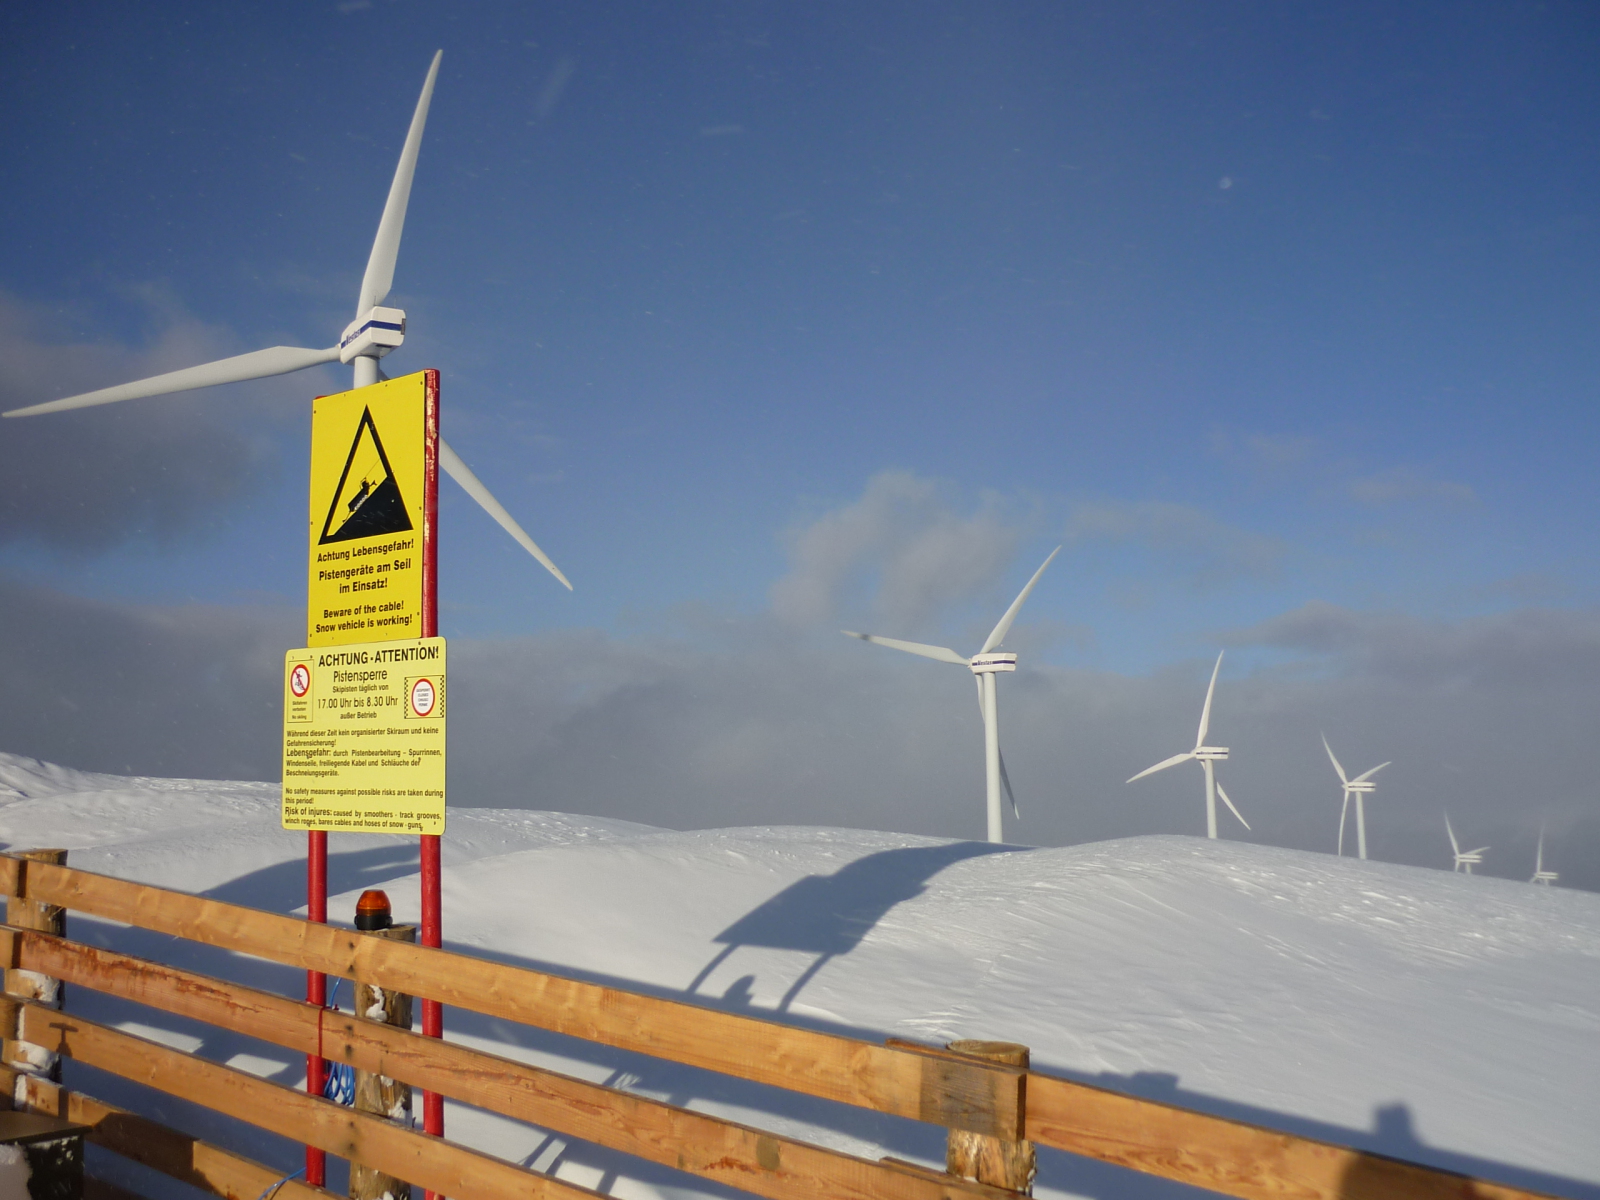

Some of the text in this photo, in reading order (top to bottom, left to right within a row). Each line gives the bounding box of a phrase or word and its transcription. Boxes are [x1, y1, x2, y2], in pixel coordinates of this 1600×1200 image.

[318, 539, 414, 562] Achtung Lebensgefahr!
[319, 565, 373, 581] Pistengeräte
[394, 558, 411, 570] Seil
[340, 578, 387, 593] im Einsatz!
[324, 600, 404, 618] Beware of the cable!
[316, 614, 412, 633] Snow vehicle is working!
[318, 652, 368, 667] ACHTUNG
[375, 646, 438, 663] ATTENTION!
[334, 670, 387, 683] Pistensperre
[332, 686, 357, 694] Skipisten
[359, 684, 377, 693] täglich
[318, 696, 398, 709] 17.00 Uhr bis 8.30 Uhr
[351, 728, 385, 737] organisierter
[286, 748, 331, 758] Lebensgefahr:
[352, 749, 401, 757] Pistenbearbeitung
[409, 749, 442, 757] Spurrinnen,
[337, 788, 356, 796] against
[358, 788, 380, 797] possible
[425, 789, 443, 798] during
[285, 807, 298, 815] Risk
